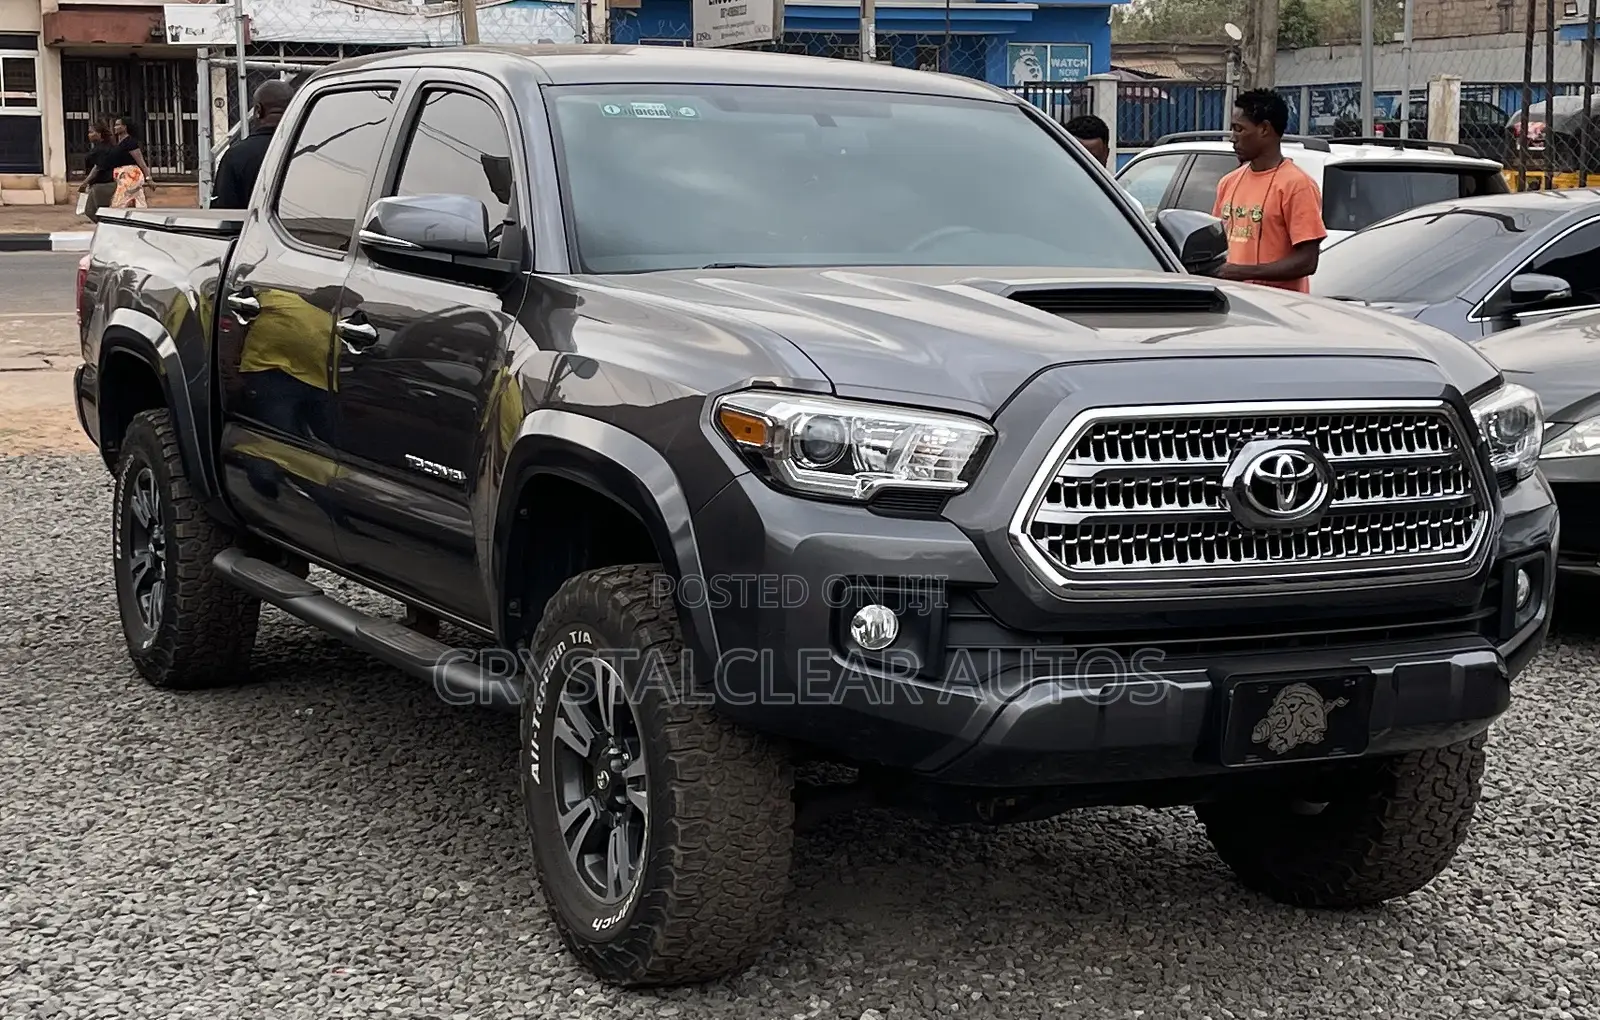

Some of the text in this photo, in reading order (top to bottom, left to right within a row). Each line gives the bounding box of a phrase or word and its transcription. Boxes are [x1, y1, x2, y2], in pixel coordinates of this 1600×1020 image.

[1050, 58, 1088, 68] WATCH
[1058, 68, 1080, 77] NOW
[568, 630, 593, 645] T/A
